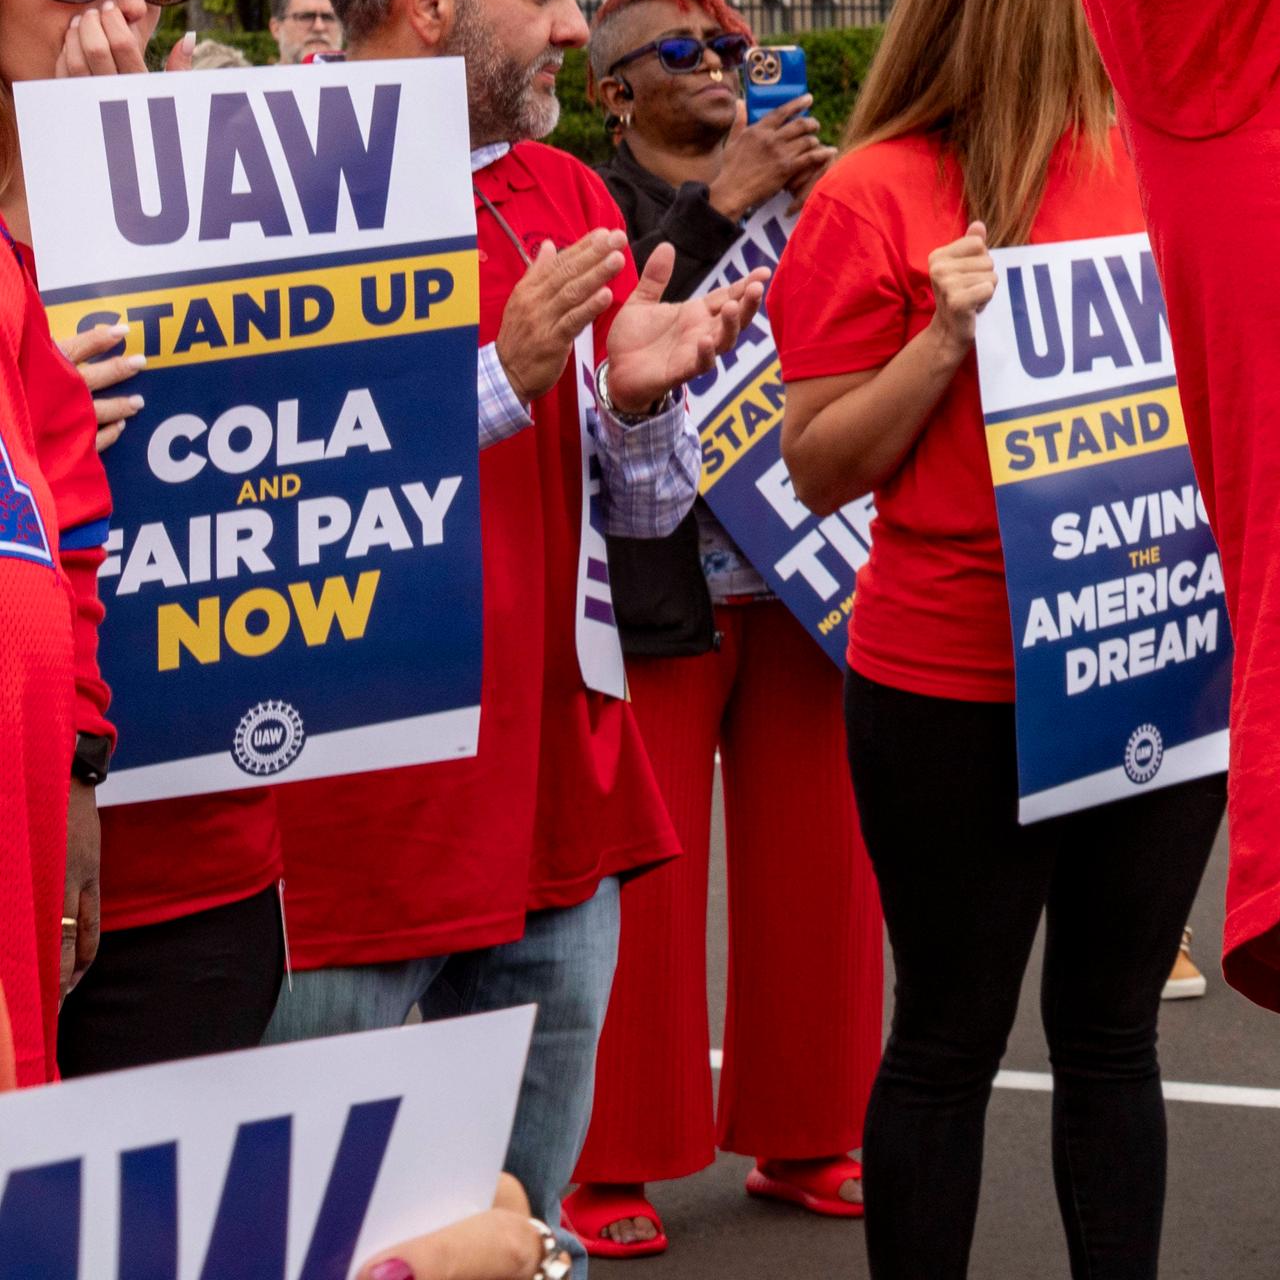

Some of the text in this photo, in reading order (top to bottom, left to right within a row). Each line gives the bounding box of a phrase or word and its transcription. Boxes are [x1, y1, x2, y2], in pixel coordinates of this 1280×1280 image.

[99, 83, 402, 247] UAW
[360, 267, 455, 326] UP
[147, 388, 392, 484] COLA
[1005, 402, 1170, 471] STAND
[237, 473, 302, 505] AND
[298, 476, 463, 567] PAY
[1022, 552, 1226, 648] AMERICA
[1129, 545, 1161, 569] THE
[157, 570, 381, 673] NOW
[1066, 608, 1219, 696] DREAM
[254, 726, 283, 747] UAW
